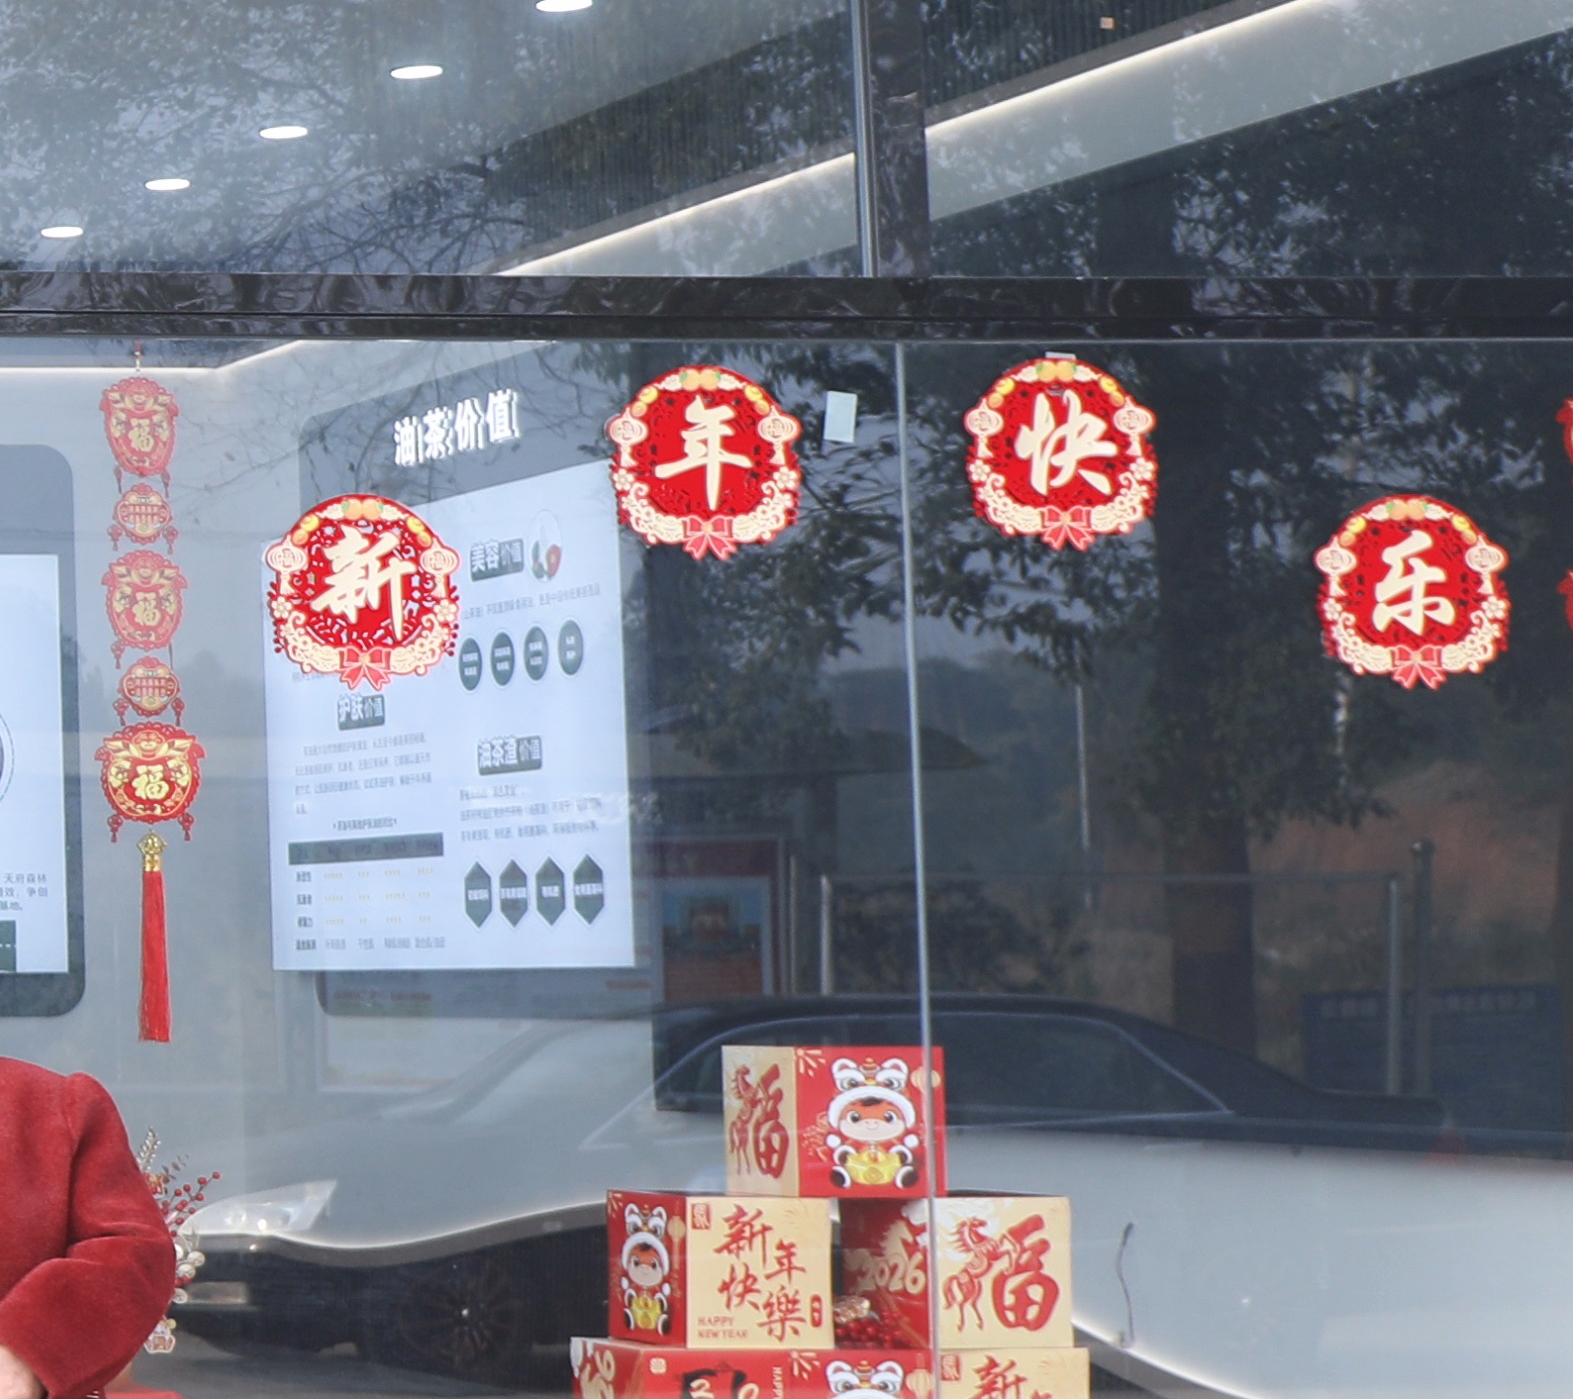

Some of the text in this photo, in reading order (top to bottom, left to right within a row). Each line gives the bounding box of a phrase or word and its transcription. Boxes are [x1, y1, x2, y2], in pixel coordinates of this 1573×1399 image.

[393, 390, 520, 467] 油茶价值
[656, 396, 751, 510] 年
[1014, 389, 1118, 496] 快
[131, 591, 162, 627] 福
[309, 524, 418, 641] 新
[1372, 530, 1455, 635] 乐
[131, 764, 170, 800] 福
[752, 1063, 789, 1179] 福
[697, 1316, 735, 1328] HAPPY
[858, 1255, 926, 1294] 2026
[991, 1213, 1061, 1333] 福
